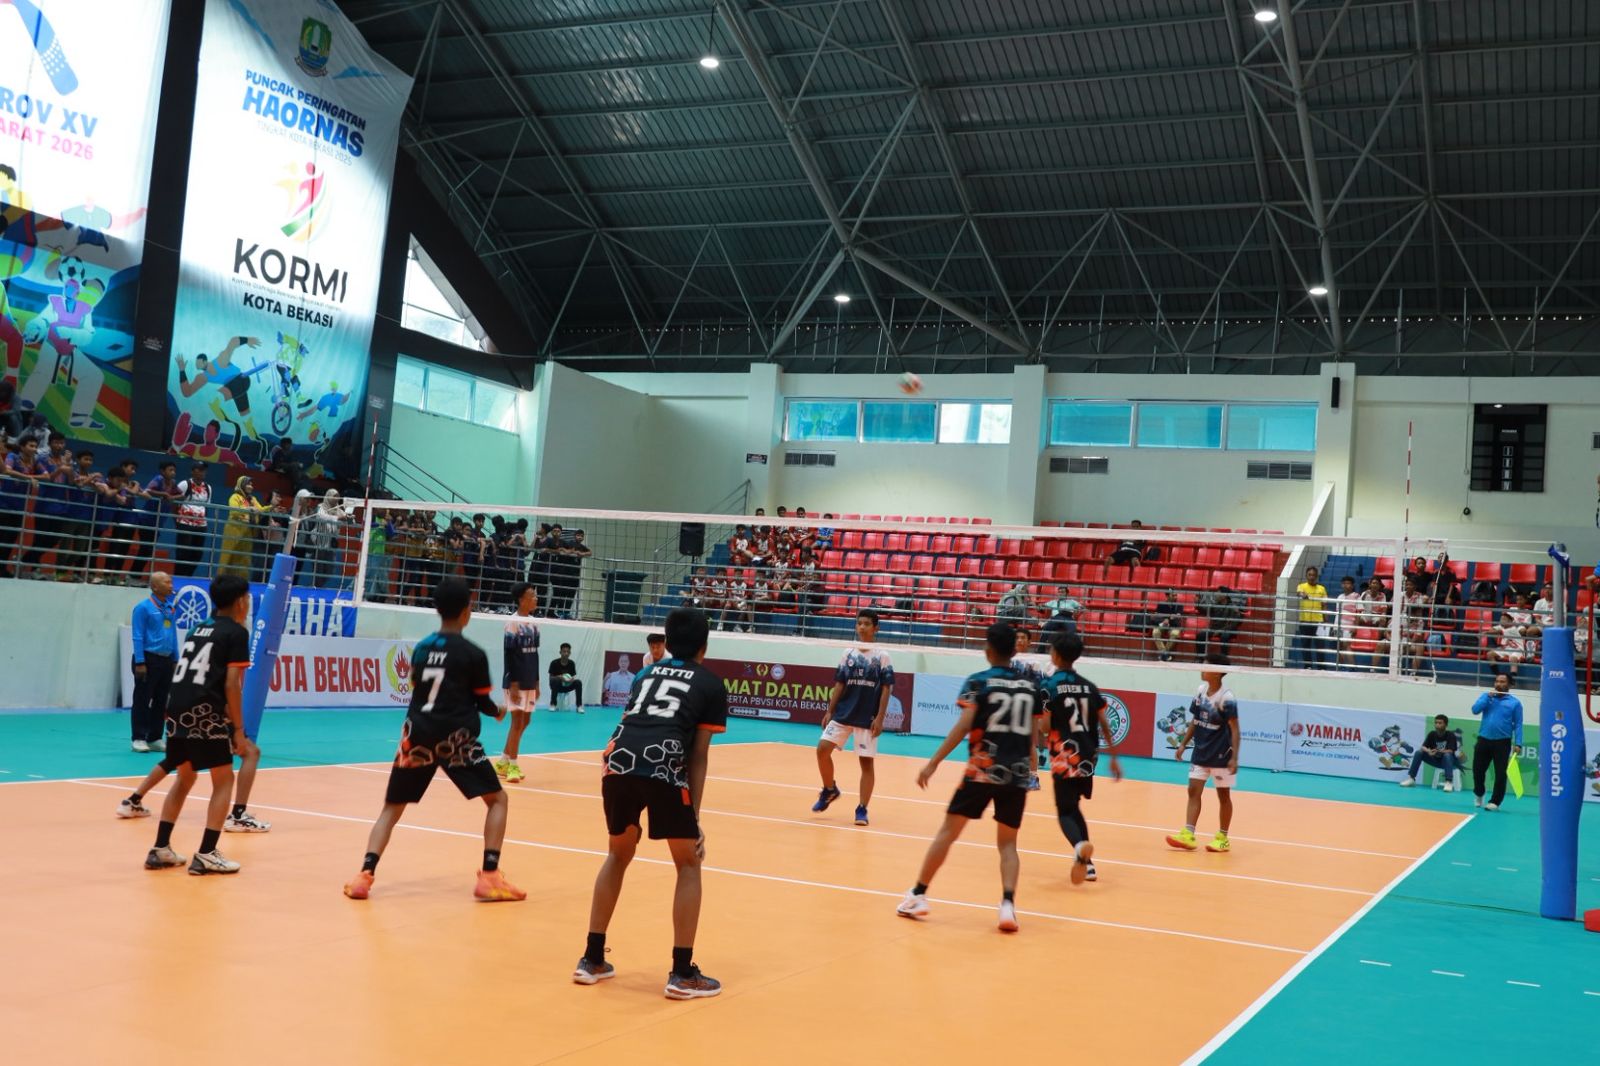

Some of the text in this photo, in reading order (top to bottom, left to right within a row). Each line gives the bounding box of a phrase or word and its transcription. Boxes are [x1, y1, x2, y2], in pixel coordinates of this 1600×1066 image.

[0, 86, 98, 138] ROV XV
[245, 69, 366, 131] PUNCAK PERINGATAN
[0, 117, 94, 160] ARAT 2026
[242, 86, 364, 157] HAORNAS
[233, 238, 348, 303] KORMI
[243, 292, 282, 315] KOTA
[286, 304, 333, 328] BEKASI
[172, 641, 214, 685] 64
[269, 655, 382, 692] OTA BEKASI
[651, 666, 694, 679] KEYTO
[421, 667, 446, 712] 7
[625, 678, 691, 718] 15
[723, 678, 762, 696] MAT
[727, 695, 829, 711] ERTA PBVSI KOTA BEKASI
[917, 702, 950, 710] PRIMAYA
[986, 692, 1034, 735] 20
[1064, 697, 1089, 733] 21
[1306, 724, 1362, 742] YAMAHA
[1259, 731, 1282, 740] Patriot
[1551, 740, 1564, 797] Senoh
